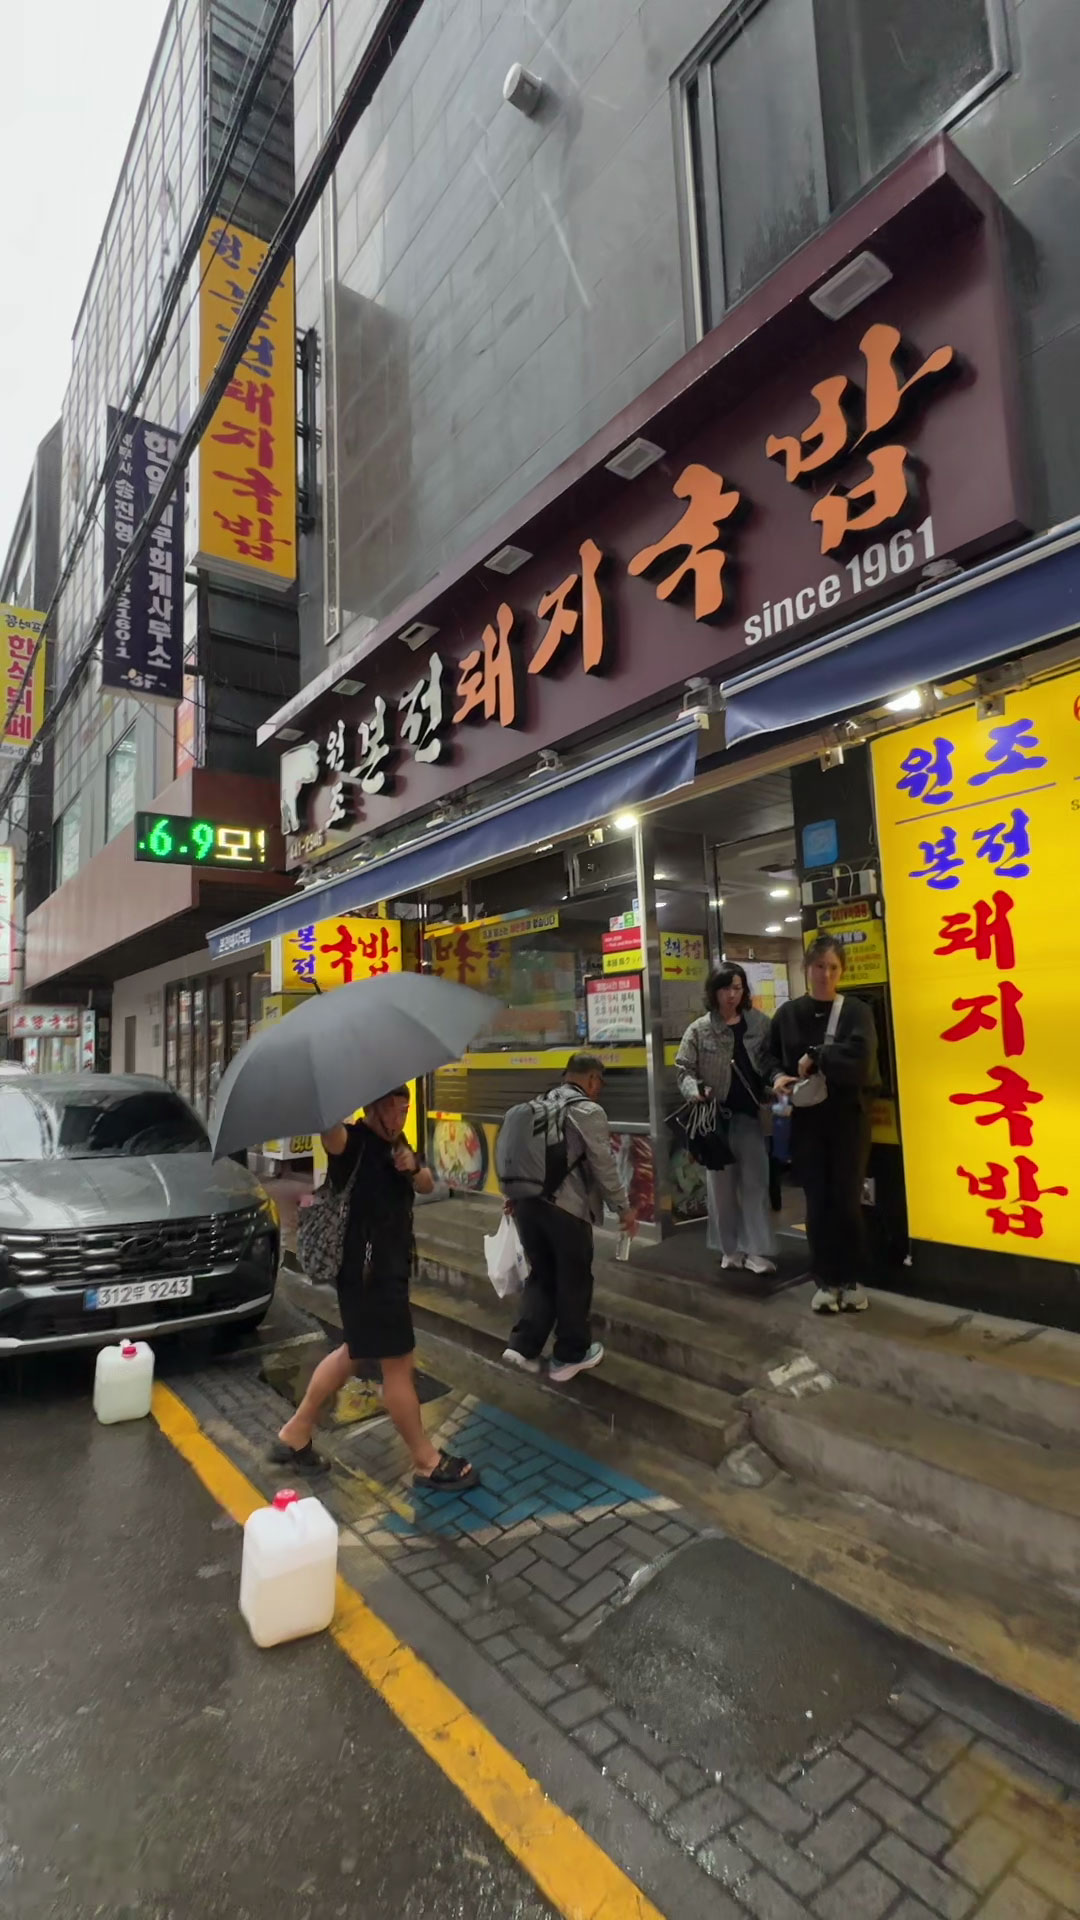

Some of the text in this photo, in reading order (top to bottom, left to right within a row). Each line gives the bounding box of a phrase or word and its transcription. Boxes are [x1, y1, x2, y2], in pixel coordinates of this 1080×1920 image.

[744, 517, 936, 646] since 1961
[896, 718, 1048, 804] 원조
[909, 808, 1031, 890] 본전
[288, 925, 317, 984] 본전
[320, 925, 398, 984] 국밥
[934, 891, 1068, 1239] 돼지국밥
[149, 1279, 189, 1300] 9243
